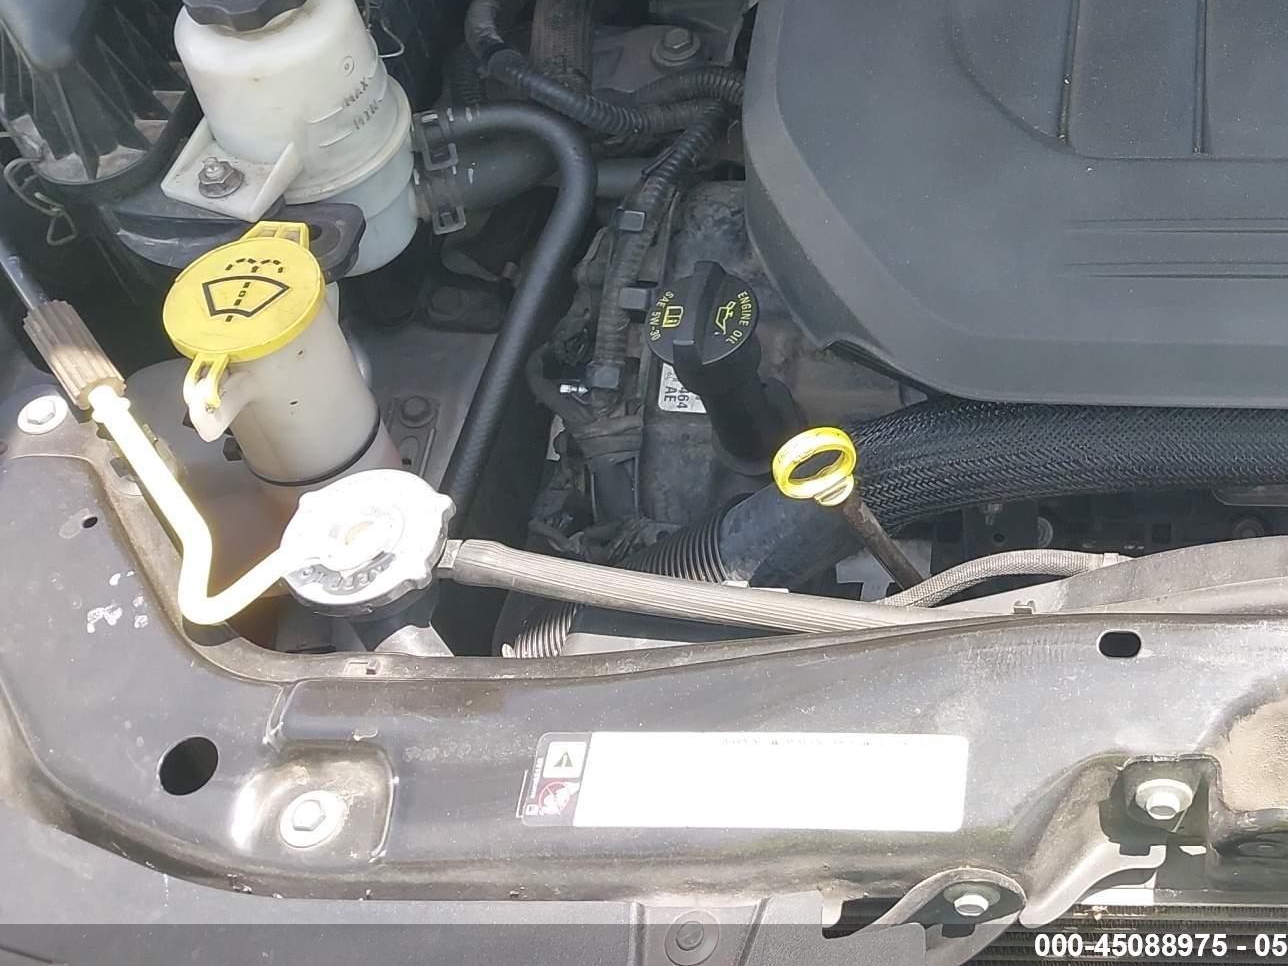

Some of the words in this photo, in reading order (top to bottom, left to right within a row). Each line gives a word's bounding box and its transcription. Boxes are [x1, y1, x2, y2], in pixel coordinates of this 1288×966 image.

[656, 291, 675, 308] SAE
[737, 291, 752, 327] ENGINE
[649, 311, 662, 341] 5W-30
[725, 329, 744, 345] OIL
[664, 386, 677, 402] AE
